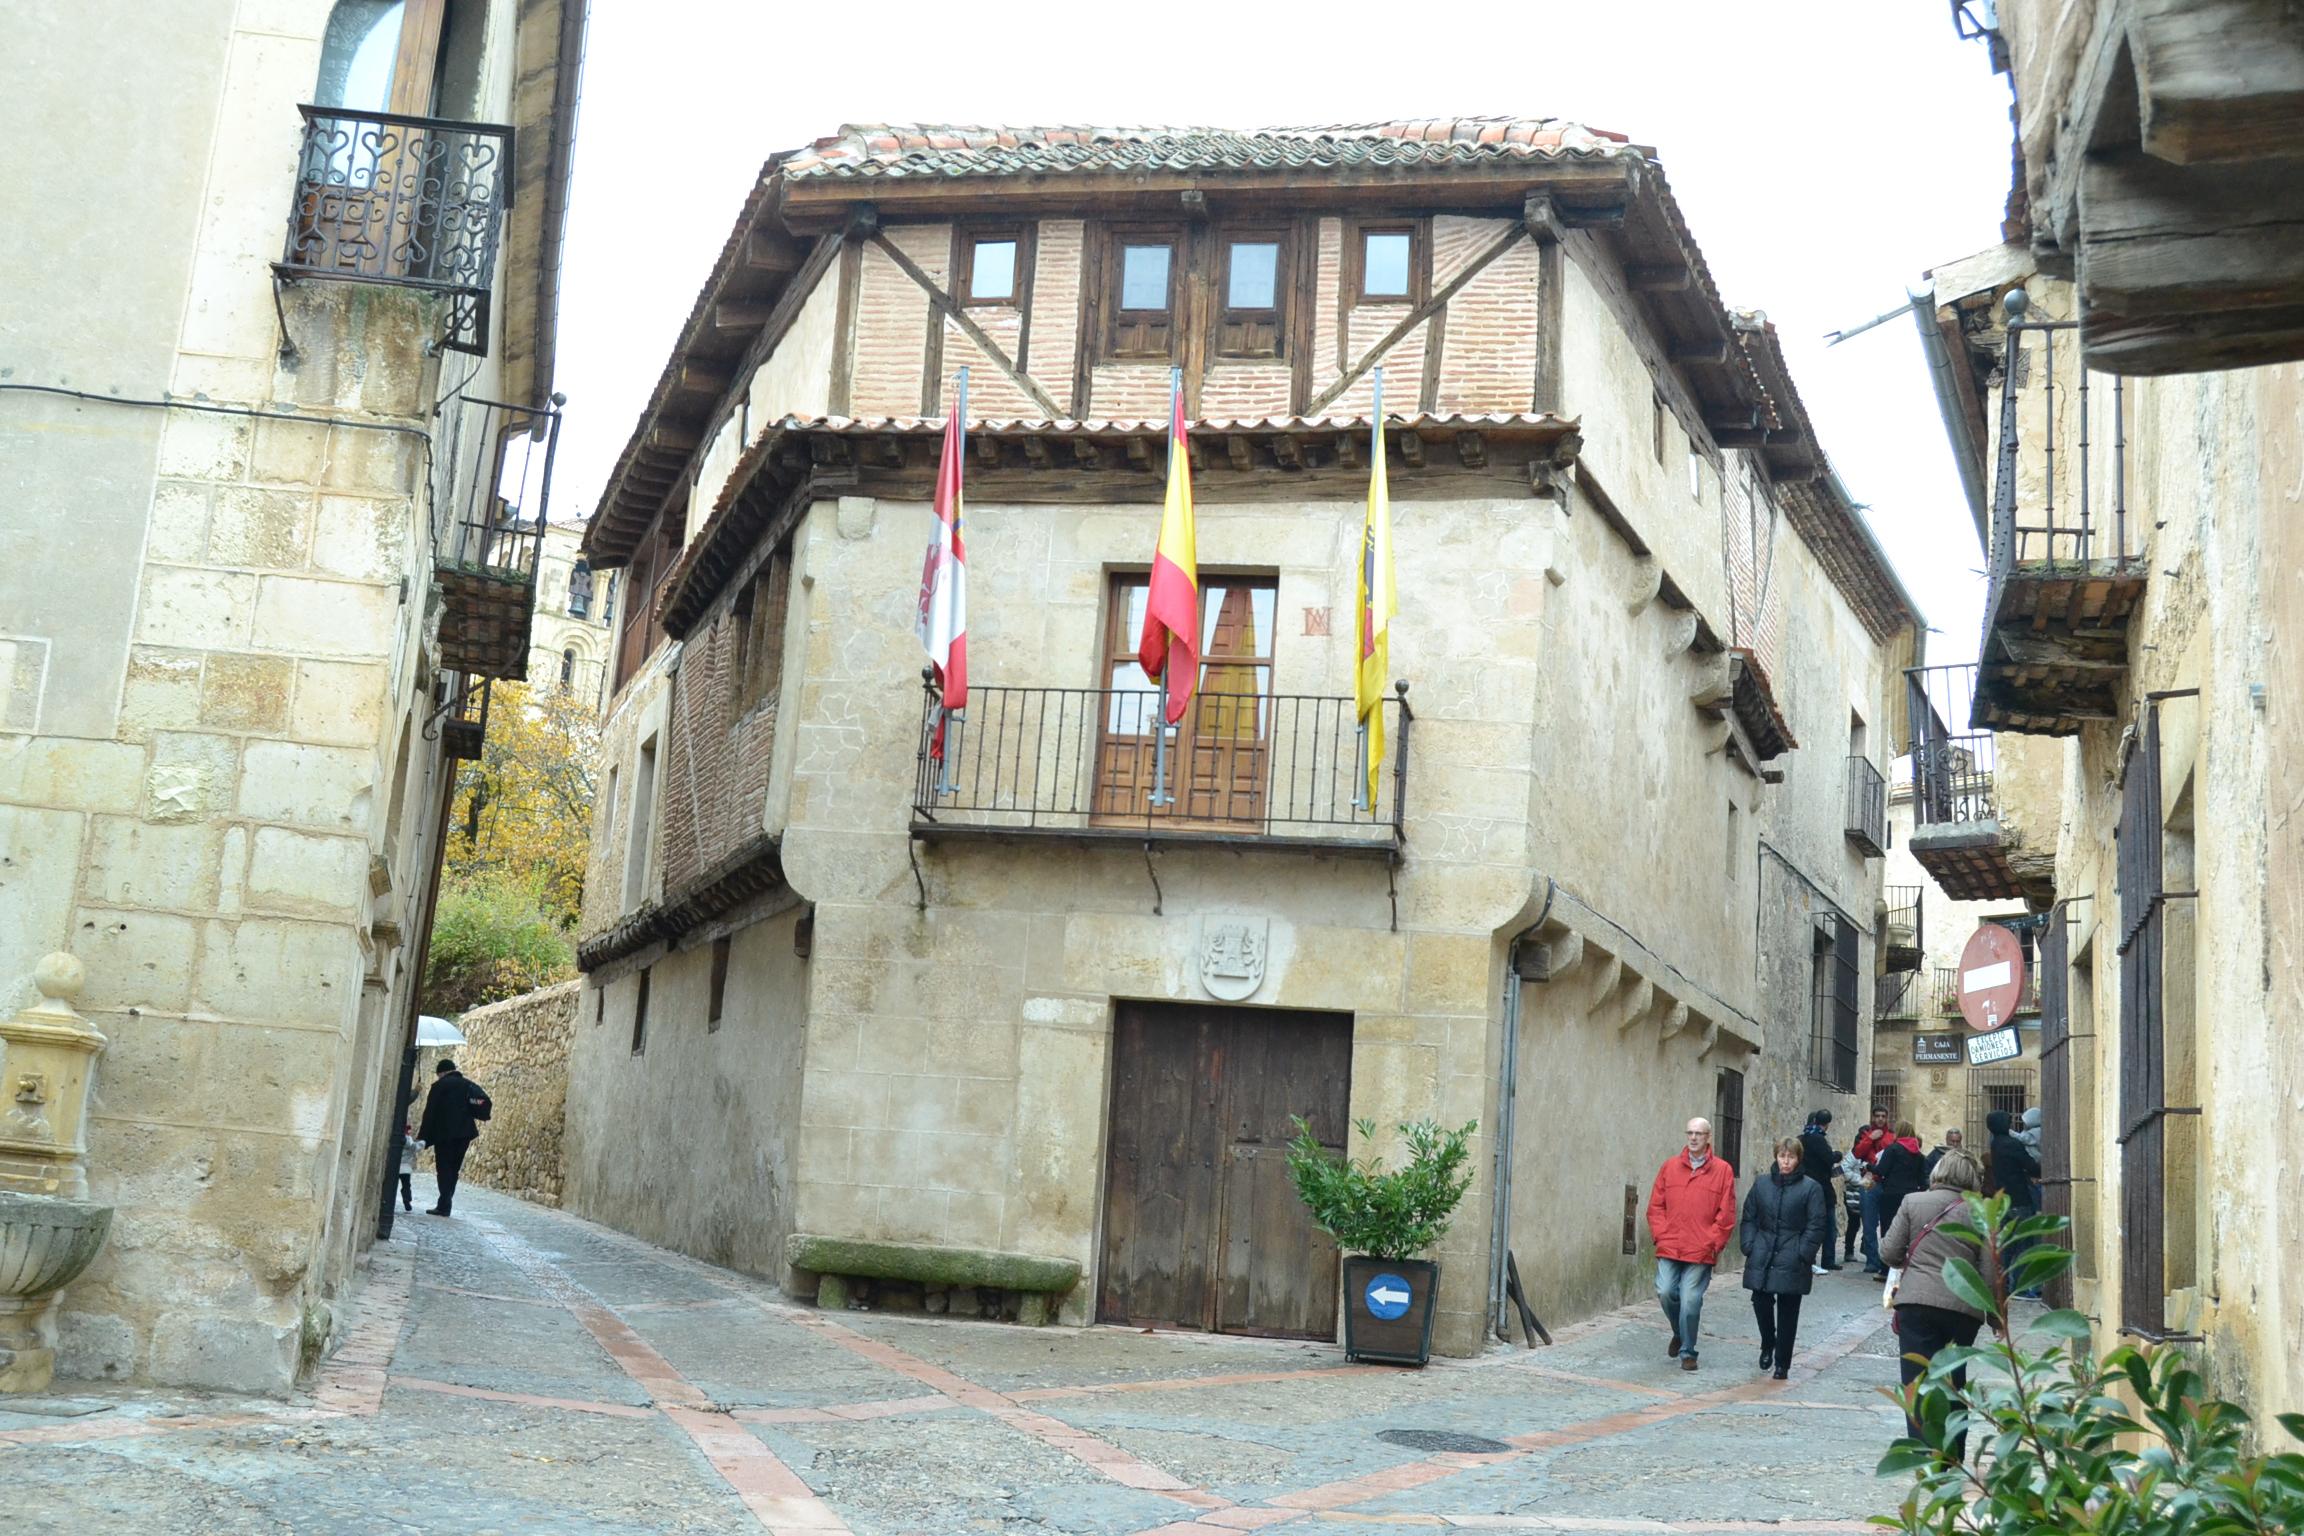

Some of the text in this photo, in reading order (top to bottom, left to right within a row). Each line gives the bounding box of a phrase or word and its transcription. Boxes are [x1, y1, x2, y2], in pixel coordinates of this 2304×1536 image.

[1976, 1031, 2005, 1045] EXCEPTO
[1970, 1039, 2004, 1054] CAMIONES
[1975, 1046, 2014, 1060] SERVICIOS
